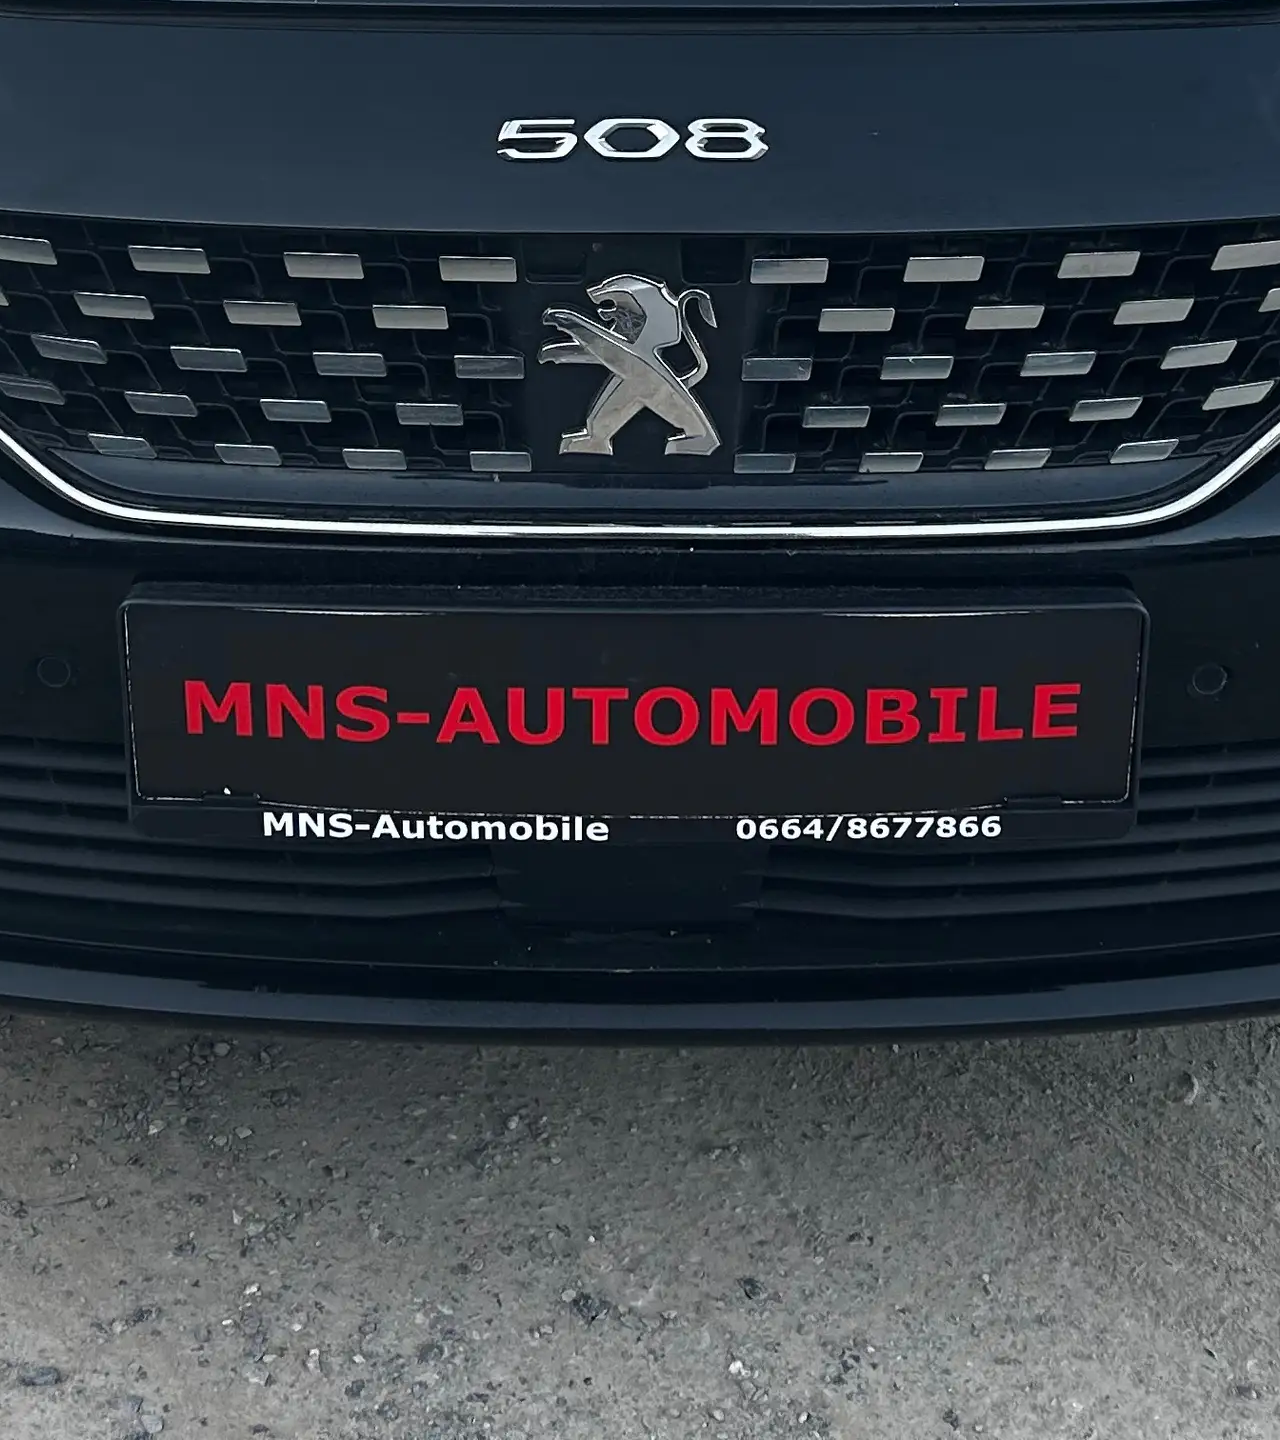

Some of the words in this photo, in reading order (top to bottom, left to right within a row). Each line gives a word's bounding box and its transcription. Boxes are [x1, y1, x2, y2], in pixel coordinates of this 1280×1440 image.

[496, 117, 770, 160] 508
[184, 679, 1082, 747] MNS-AUTOMOBILE
[263, 811, 610, 841] MNS-Automobile
[735, 815, 1002, 842] 0664/8677866
